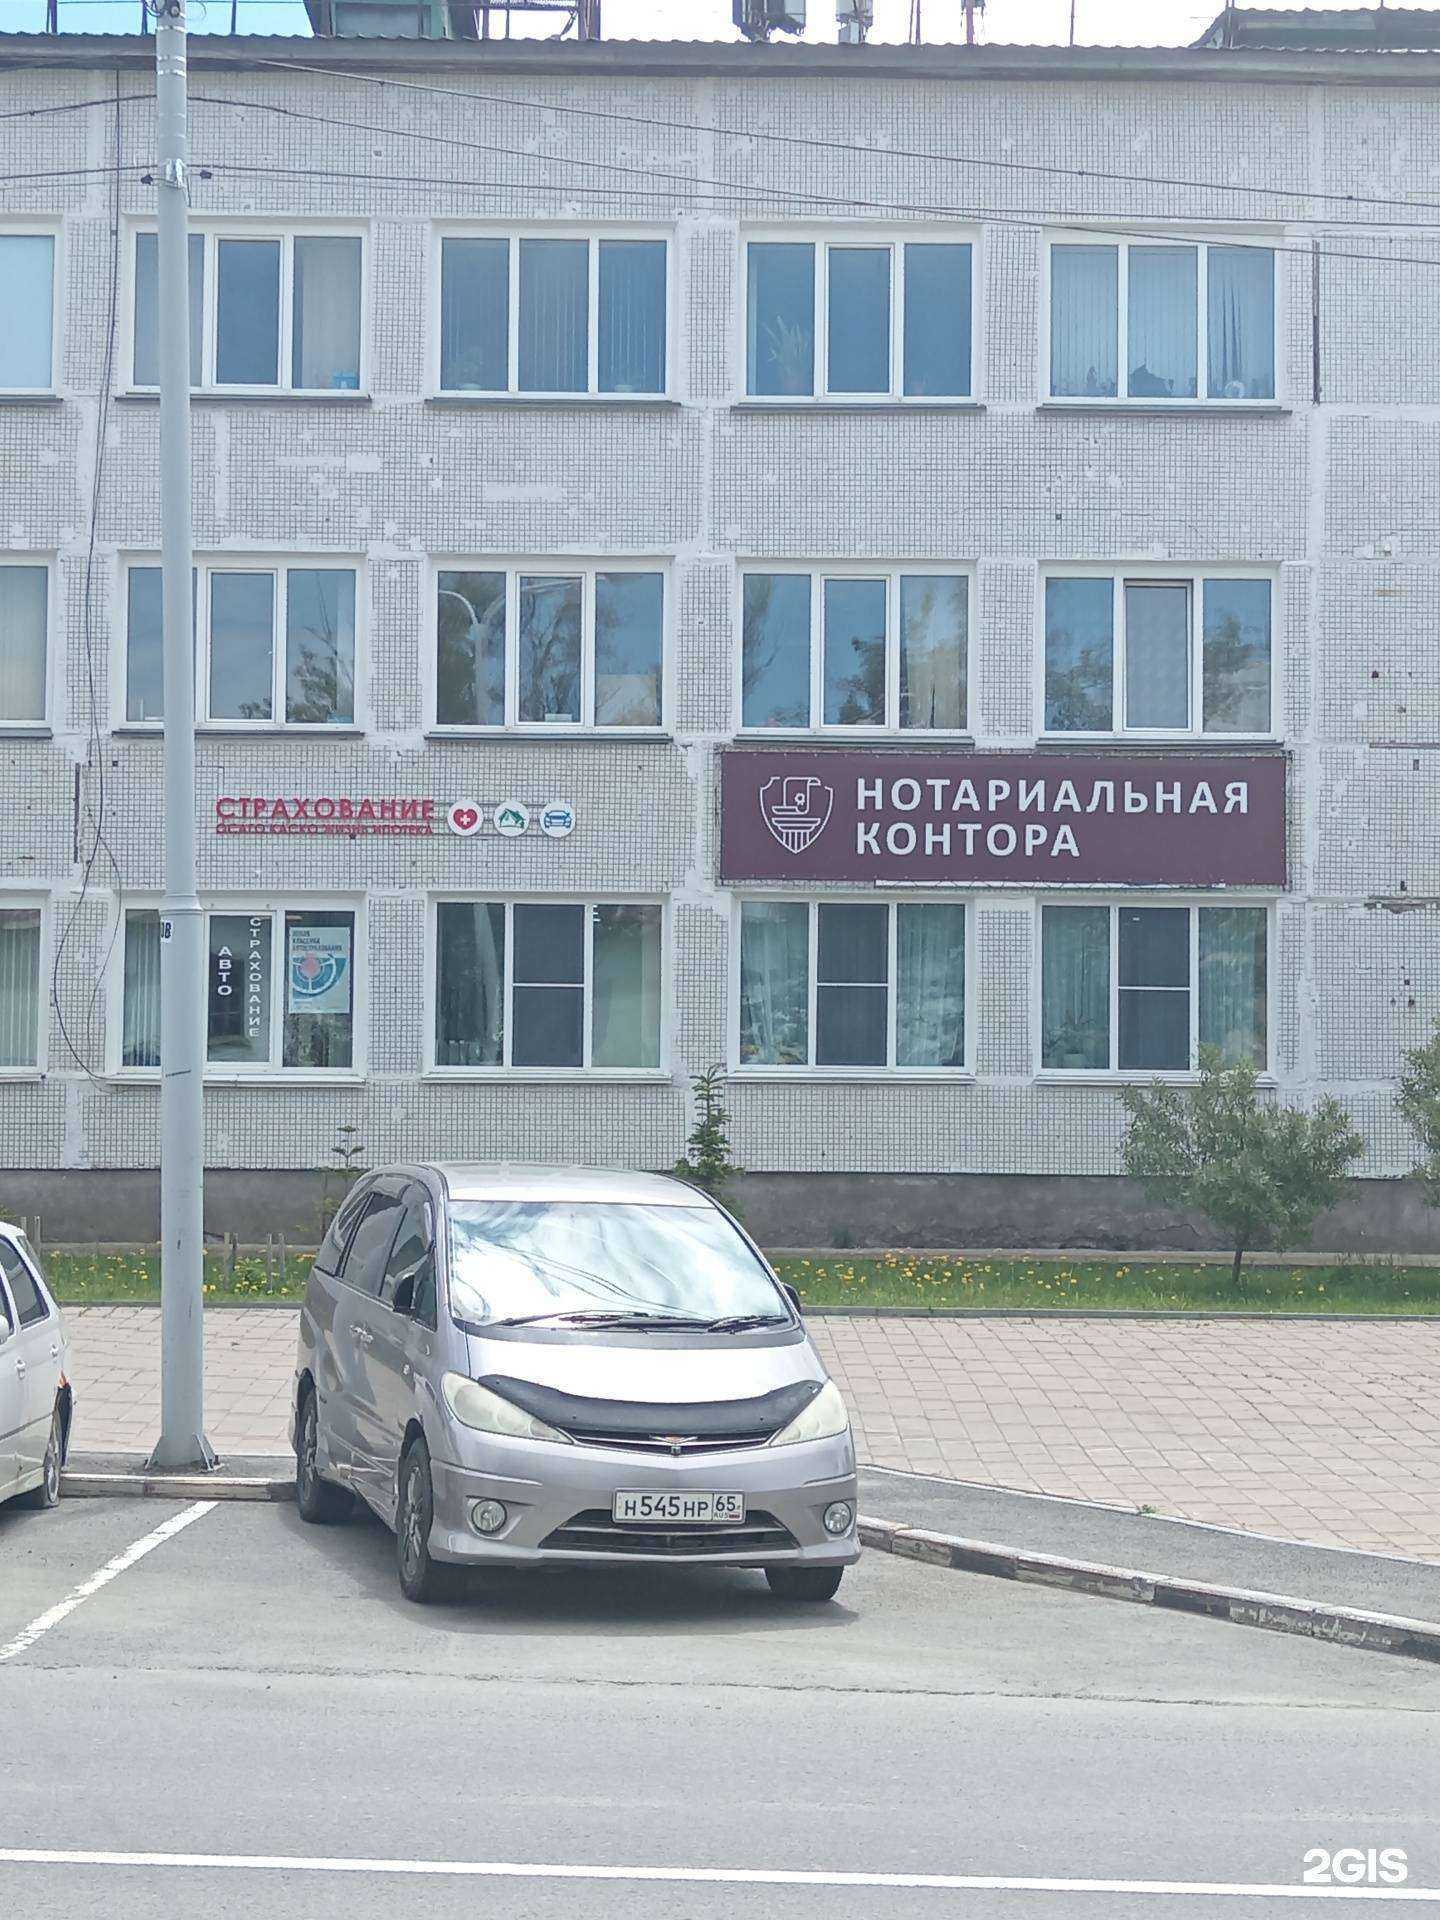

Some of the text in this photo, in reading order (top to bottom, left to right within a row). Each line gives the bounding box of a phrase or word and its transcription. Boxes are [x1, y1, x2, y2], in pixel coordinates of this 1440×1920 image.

[215, 797, 436, 819] СТРАХОВАНИЕ
[855, 778, 1250, 814] НОТАРИАЛЬНАЯ
[855, 823, 1080, 857] КОНТОРА
[217, 946, 233, 996] АВТО
[249, 917, 263, 1038] СТРАХОВАНИЕ
[624, 1496, 736, 1518] Н545НР 65
